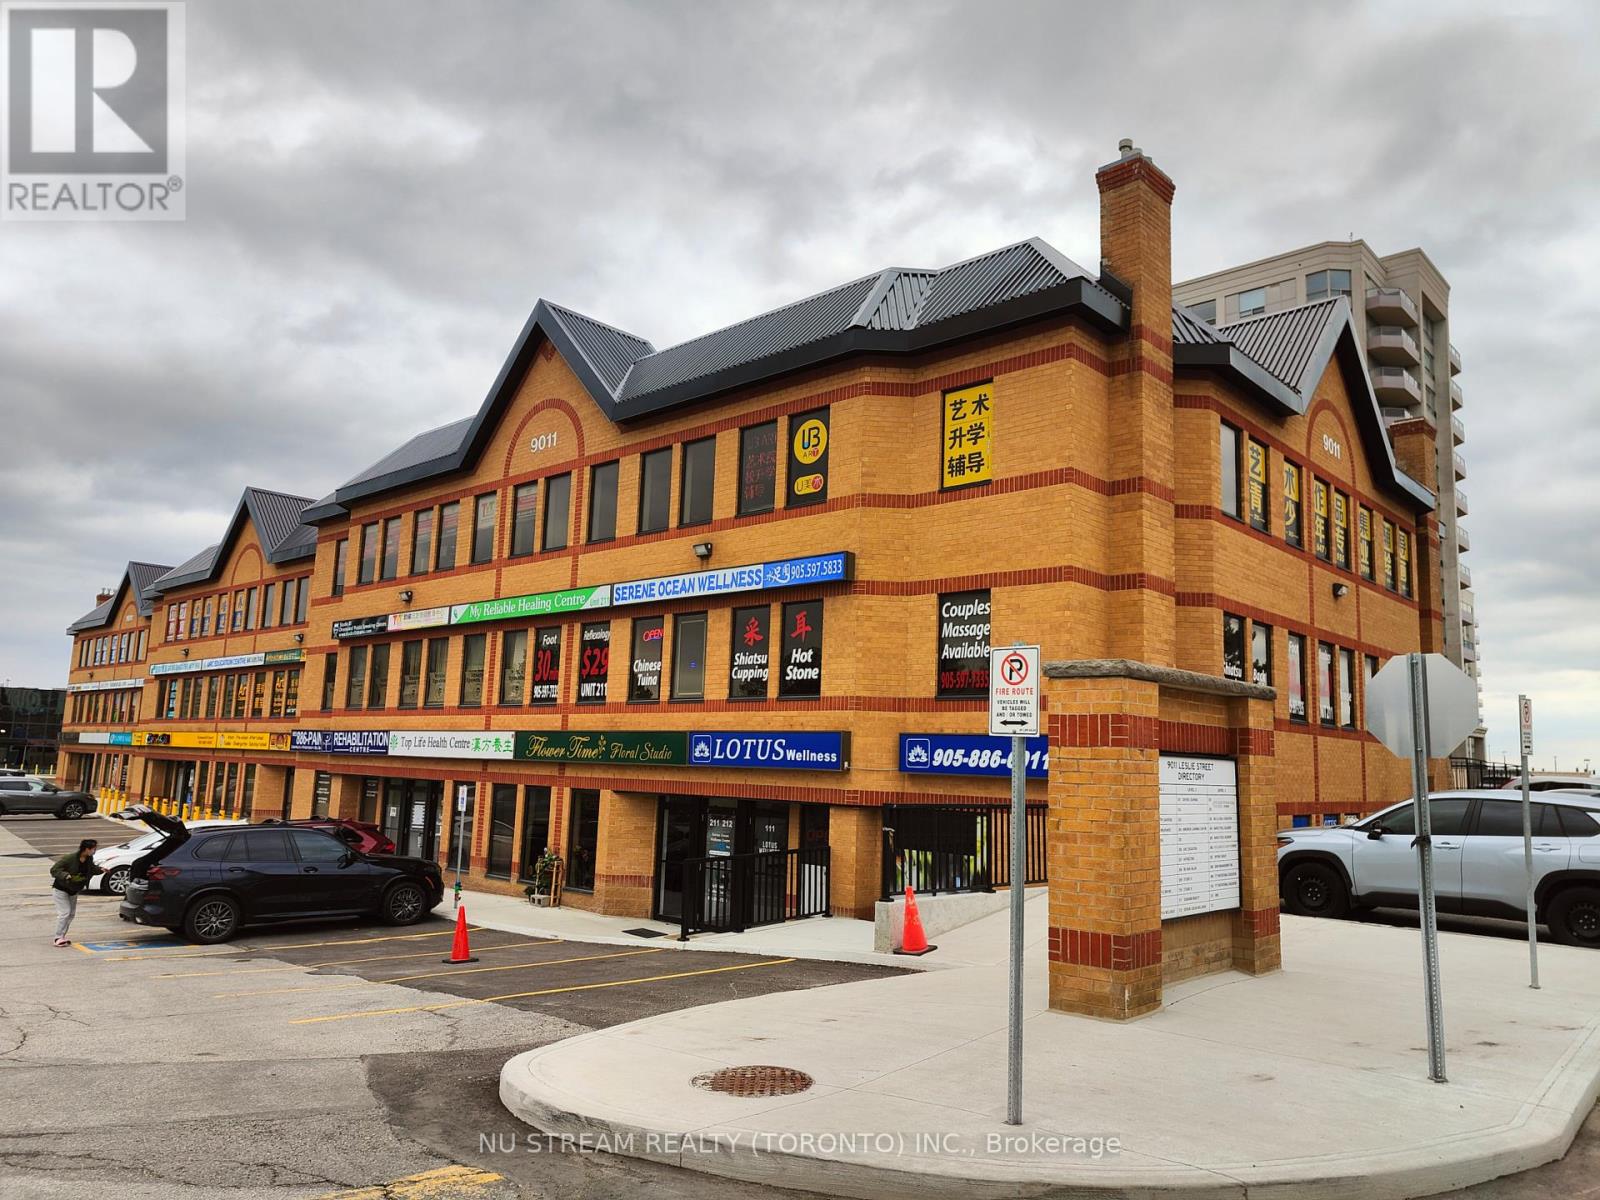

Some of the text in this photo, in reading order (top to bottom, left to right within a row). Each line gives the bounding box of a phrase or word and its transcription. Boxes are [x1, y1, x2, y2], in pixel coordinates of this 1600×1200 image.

[949, 393, 990, 421] 艺术
[530, 431, 557, 453] 9011
[948, 422, 986, 450] 升学
[1322, 434, 1341, 460] 9011
[947, 451, 985, 478] 辅导
[791, 559, 843, 580] 905.597.5833
[614, 568, 763, 602] SERENE OCEAN WELLNESS
[469, 593, 586, 618] My Reliable Healing Centre
[941, 599, 991, 620] Couples
[790, 611, 812, 643] 耳
[941, 622, 990, 640] Massage
[542, 634, 558, 646] Foot
[734, 652, 768, 666] Shiatsu
[791, 647, 813, 664] Hot
[941, 642, 990, 660] Available
[535, 649, 551, 682] 30
[581, 647, 609, 680] $29
[634, 658, 662, 673] Chinese
[786, 664, 820, 681] Stone
[637, 673, 658, 687] Tuina
[732, 664, 769, 682] Cupping
[581, 683, 596, 697] UNIT
[995, 687, 1034, 696] FIRE ROUTE
[333, 731, 388, 746] REHABILITATION
[401, 736, 471, 750] Top Life Health Centre
[525, 734, 566, 758] Flower
[610, 742, 673, 761] Floral Studio
[713, 738, 786, 761] LOTUS
[787, 749, 837, 763] Wellness
[1178, 761, 1196, 770] LESLIE
[1196, 762, 1214, 771] STREET
[1178, 772, 1205, 781] DIRECTORY
[709, 818, 733, 828] 211 212
[765, 824, 775, 832] 111
[762, 840, 778, 849] LOTUS
